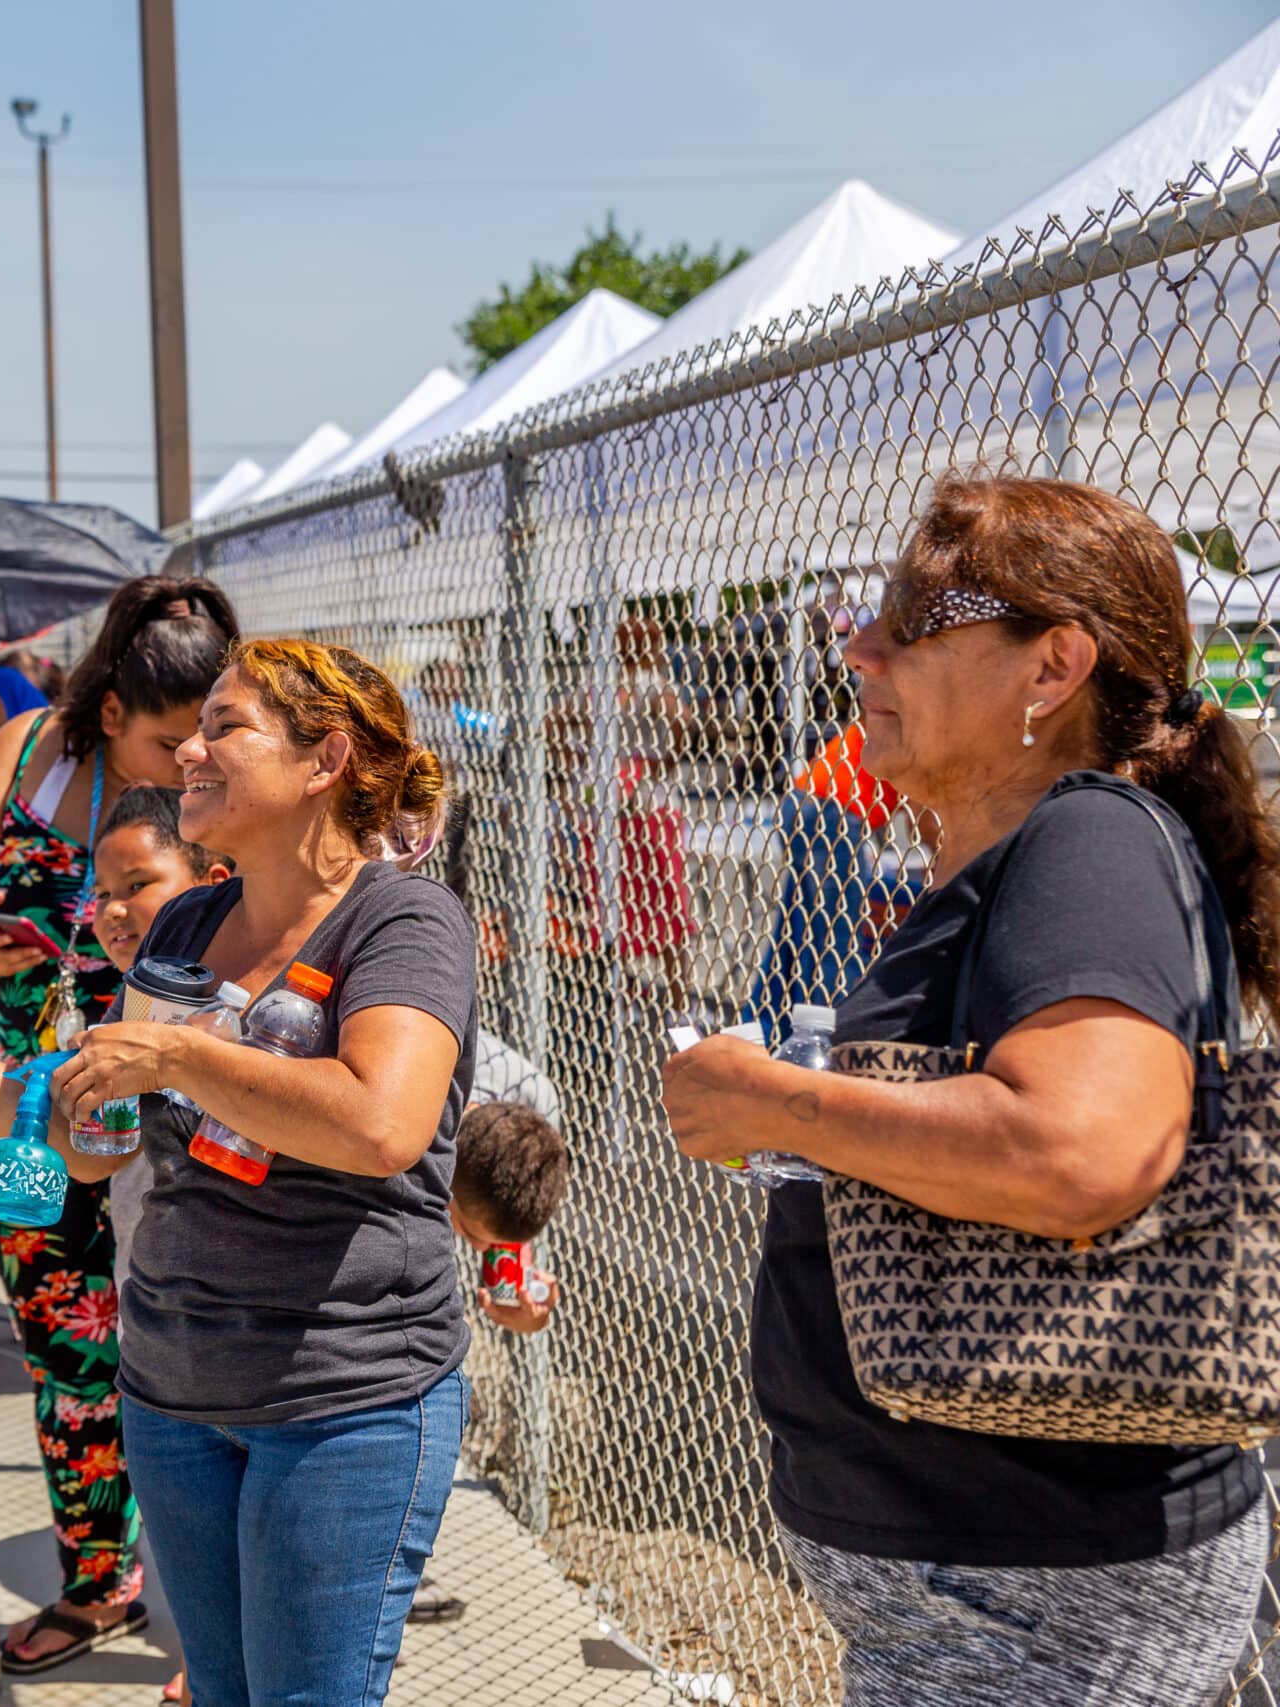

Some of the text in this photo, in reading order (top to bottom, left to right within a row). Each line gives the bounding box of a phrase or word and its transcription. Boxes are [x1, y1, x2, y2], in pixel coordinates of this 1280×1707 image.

[849, 1047, 887, 1071] MK
[893, 1048, 934, 1073] MK
[839, 1203, 875, 1228] MK
[857, 1229, 895, 1251] MK
[900, 1231, 943, 1259] MK
[968, 1233, 1011, 1253] MK
[1165, 1235, 1210, 1260] MK
[840, 1256, 870, 1282] MK
[875, 1256, 917, 1279] MK
[943, 1257, 983, 1278] MK
[988, 1257, 1030, 1279] MK
[1036, 1256, 1081, 1280] MK
[1086, 1255, 1131, 1282] MK
[1137, 1261, 1182, 1288] MK
[1188, 1264, 1233, 1291] MK
[854, 1282, 890, 1307] MK
[895, 1282, 937, 1309] MK
[962, 1282, 1006, 1307] MK
[1011, 1283, 1056, 1308] MK
[1060, 1284, 1105, 1311] MK
[1111, 1288, 1156, 1316] MK
[1162, 1292, 1208, 1320] MK
[872, 1308, 912, 1331] MK
[937, 1309, 979, 1333] MK
[984, 1311, 1027, 1336] MK
[1032, 1312, 1077, 1339] MK
[1084, 1316, 1130, 1344] MK
[1134, 1320, 1181, 1349] MK
[1186, 1325, 1232, 1353] MK
[856, 1336, 886, 1362] MK
[890, 1335, 933, 1360] MK
[958, 1337, 1003, 1364] MK
[1008, 1340, 1052, 1367] MK
[1057, 1344, 1103, 1372] MK
[1108, 1347, 1155, 1377] MK
[1160, 1352, 1207, 1382] MK
[1238, 1361, 1279, 1392] MK
